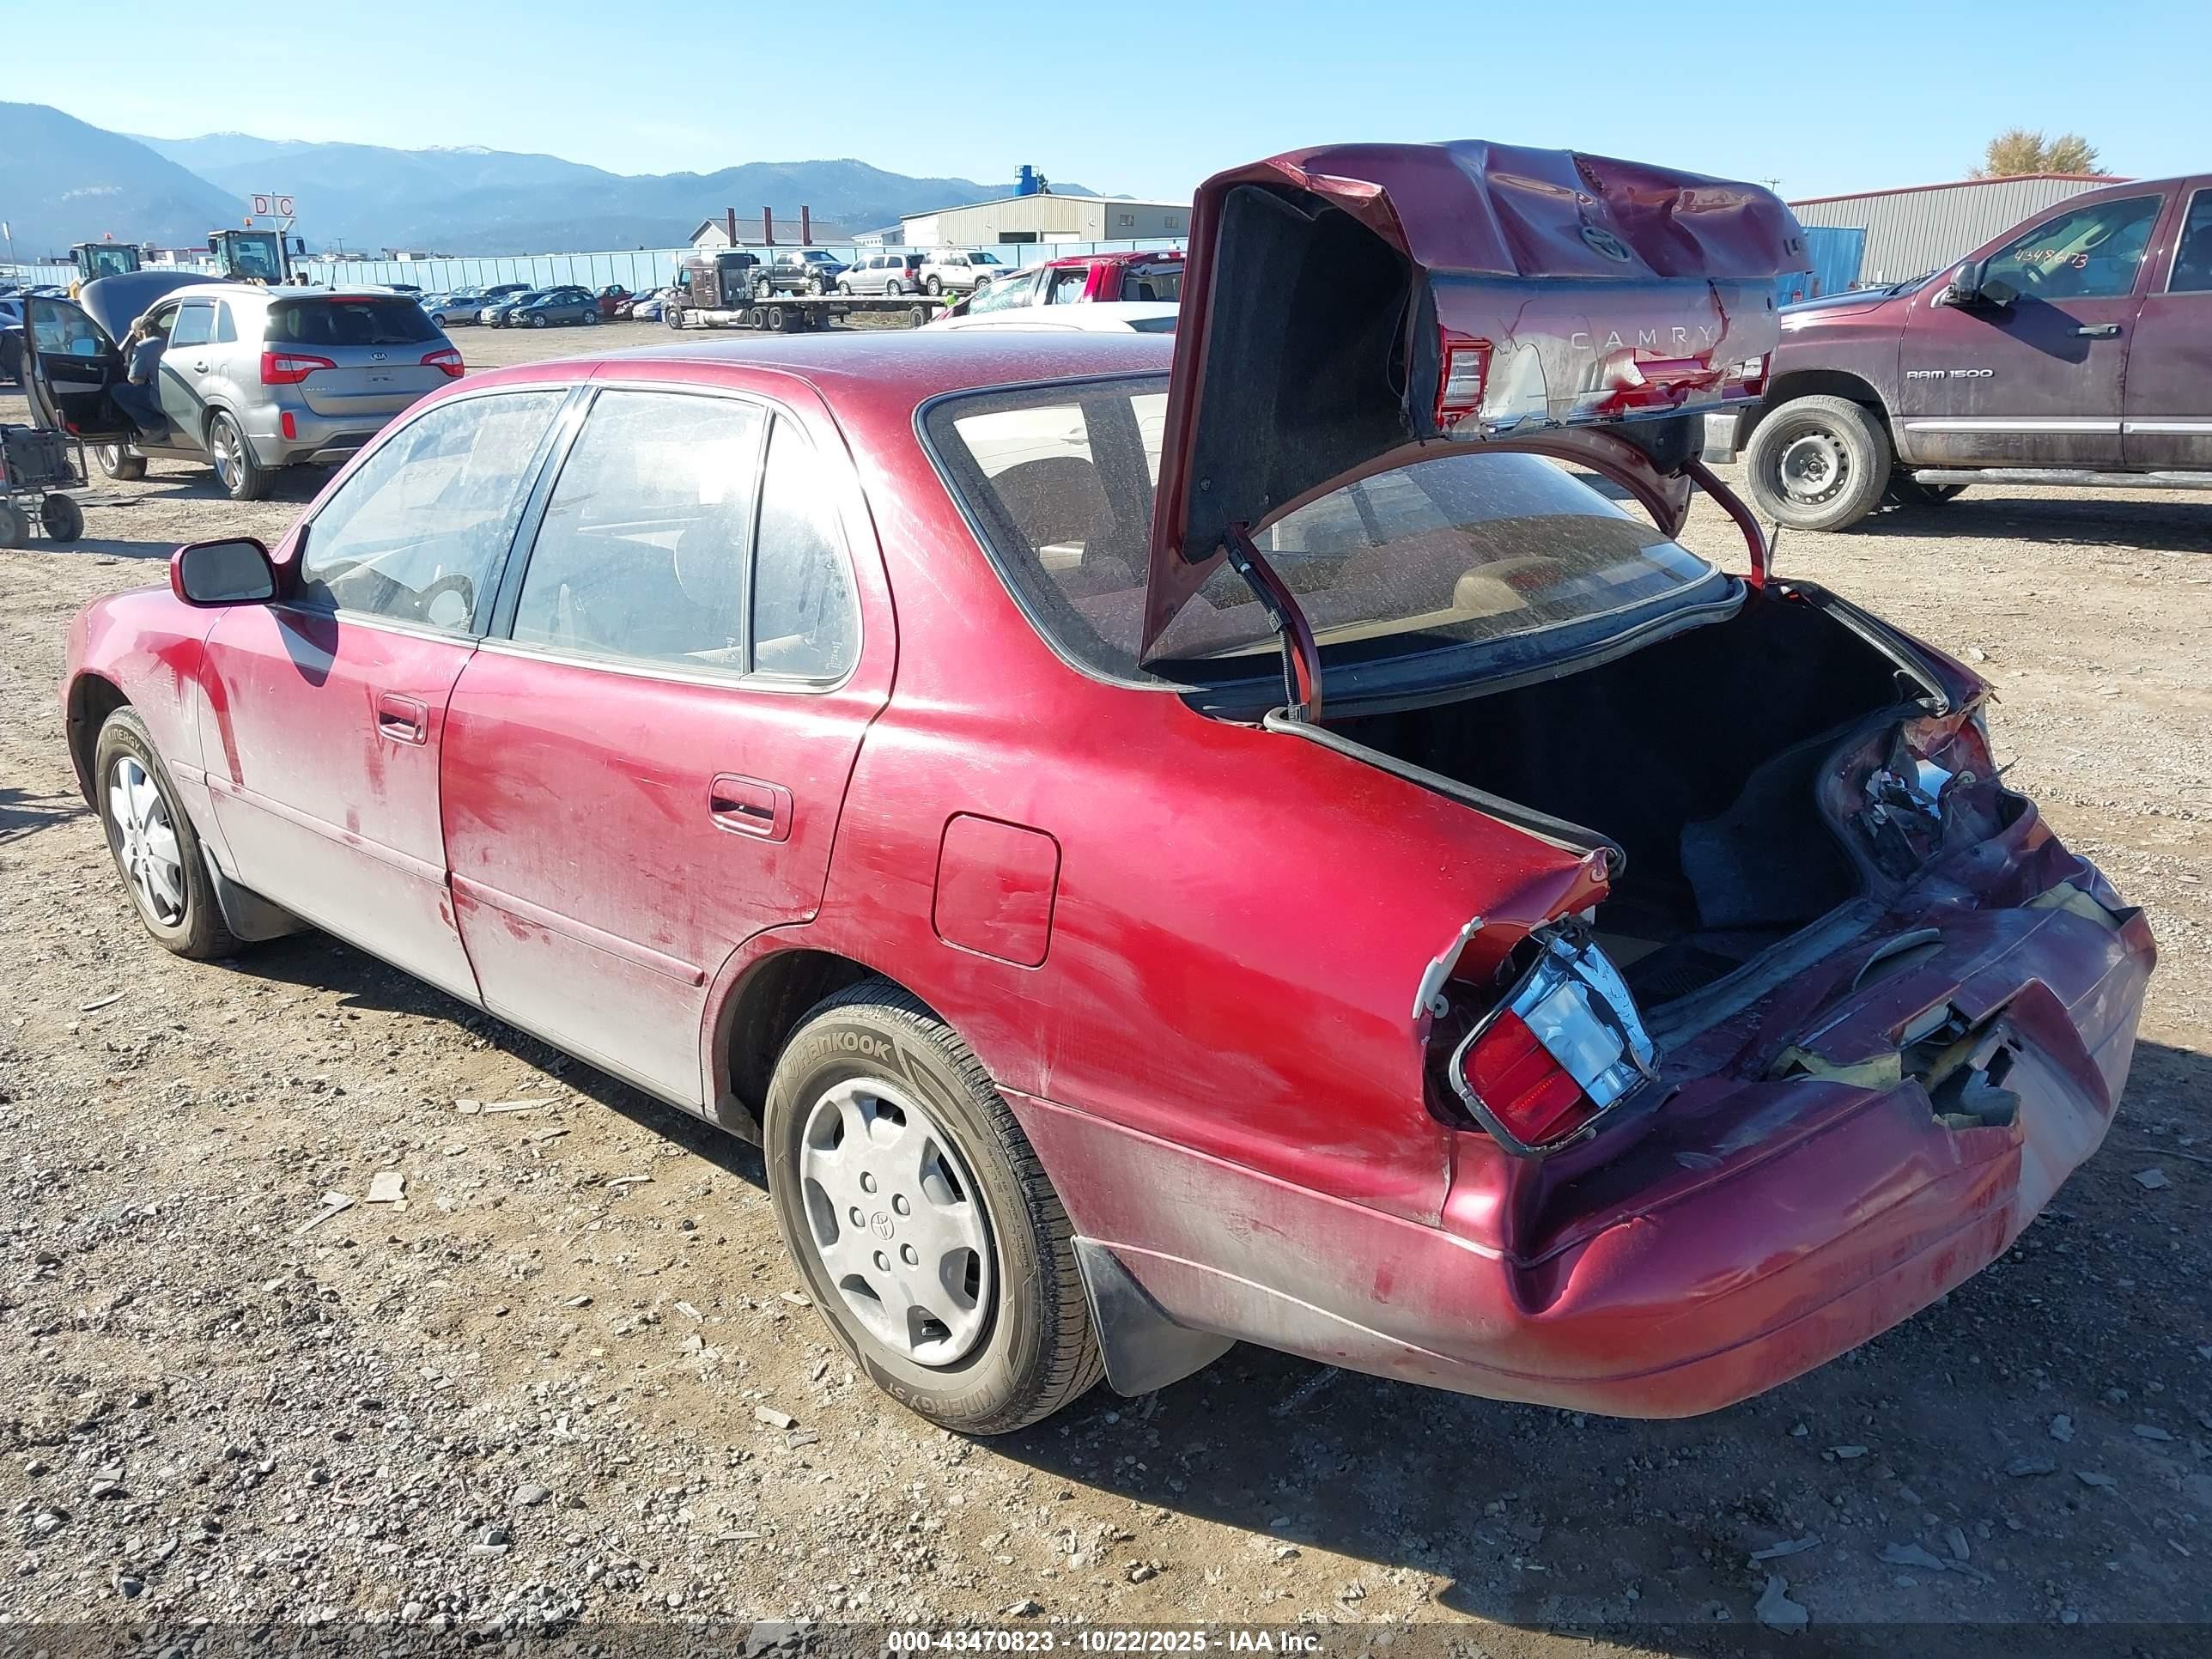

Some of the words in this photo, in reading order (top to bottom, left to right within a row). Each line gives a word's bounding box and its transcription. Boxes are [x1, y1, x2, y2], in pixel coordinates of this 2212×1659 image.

[255, 197, 268, 214] D
[280, 198, 294, 216] C
[1571, 325, 1713, 349] CAMRY
[1906, 370, 1946, 379] RAM
[1948, 369, 1994, 379] 1500
[885, 1382, 906, 1401] ST
